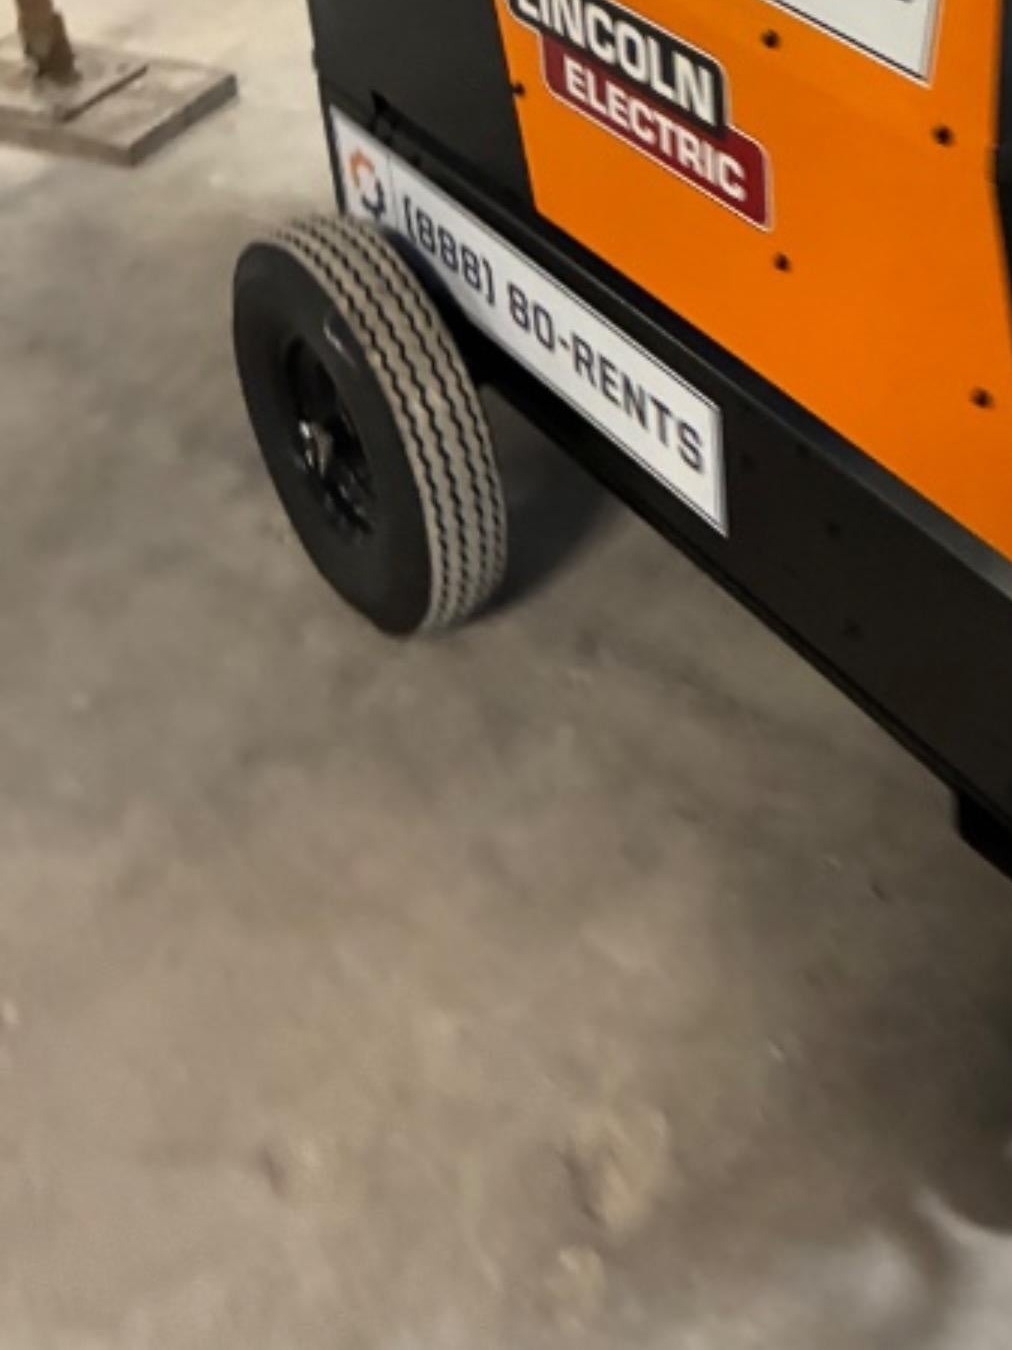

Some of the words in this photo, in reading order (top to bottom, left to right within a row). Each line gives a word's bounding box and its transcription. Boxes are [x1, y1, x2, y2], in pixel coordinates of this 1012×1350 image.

[562, 54, 746, 202] ELECTRIC
[403, 196, 496, 307] (888)
[508, 281, 706, 477] 80-RENTS
